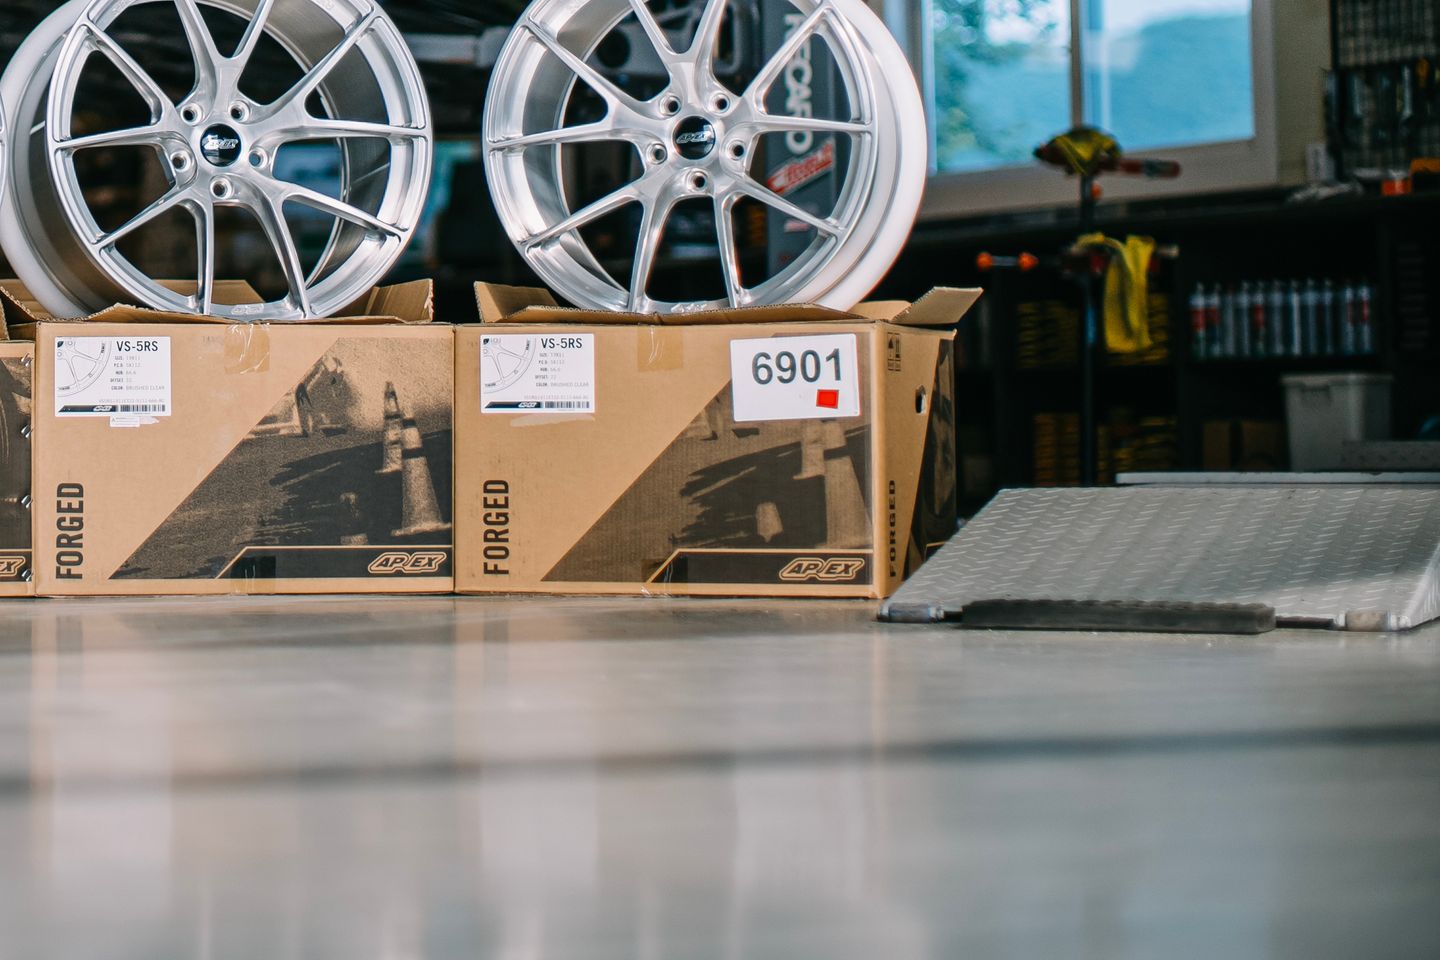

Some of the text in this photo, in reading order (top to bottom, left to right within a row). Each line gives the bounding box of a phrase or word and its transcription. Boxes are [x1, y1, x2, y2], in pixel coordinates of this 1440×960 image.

[116, 341, 158, 352] VS-5RS
[541, 338, 582, 349] VS-5RS
[752, 348, 841, 385] 6901
[55, 482, 84, 580] FORGED
[482, 479, 510, 575] FORGED
[888, 480, 896, 577] FORGED
[372, 555, 442, 570] APEX
[784, 560, 860, 578] APEX
